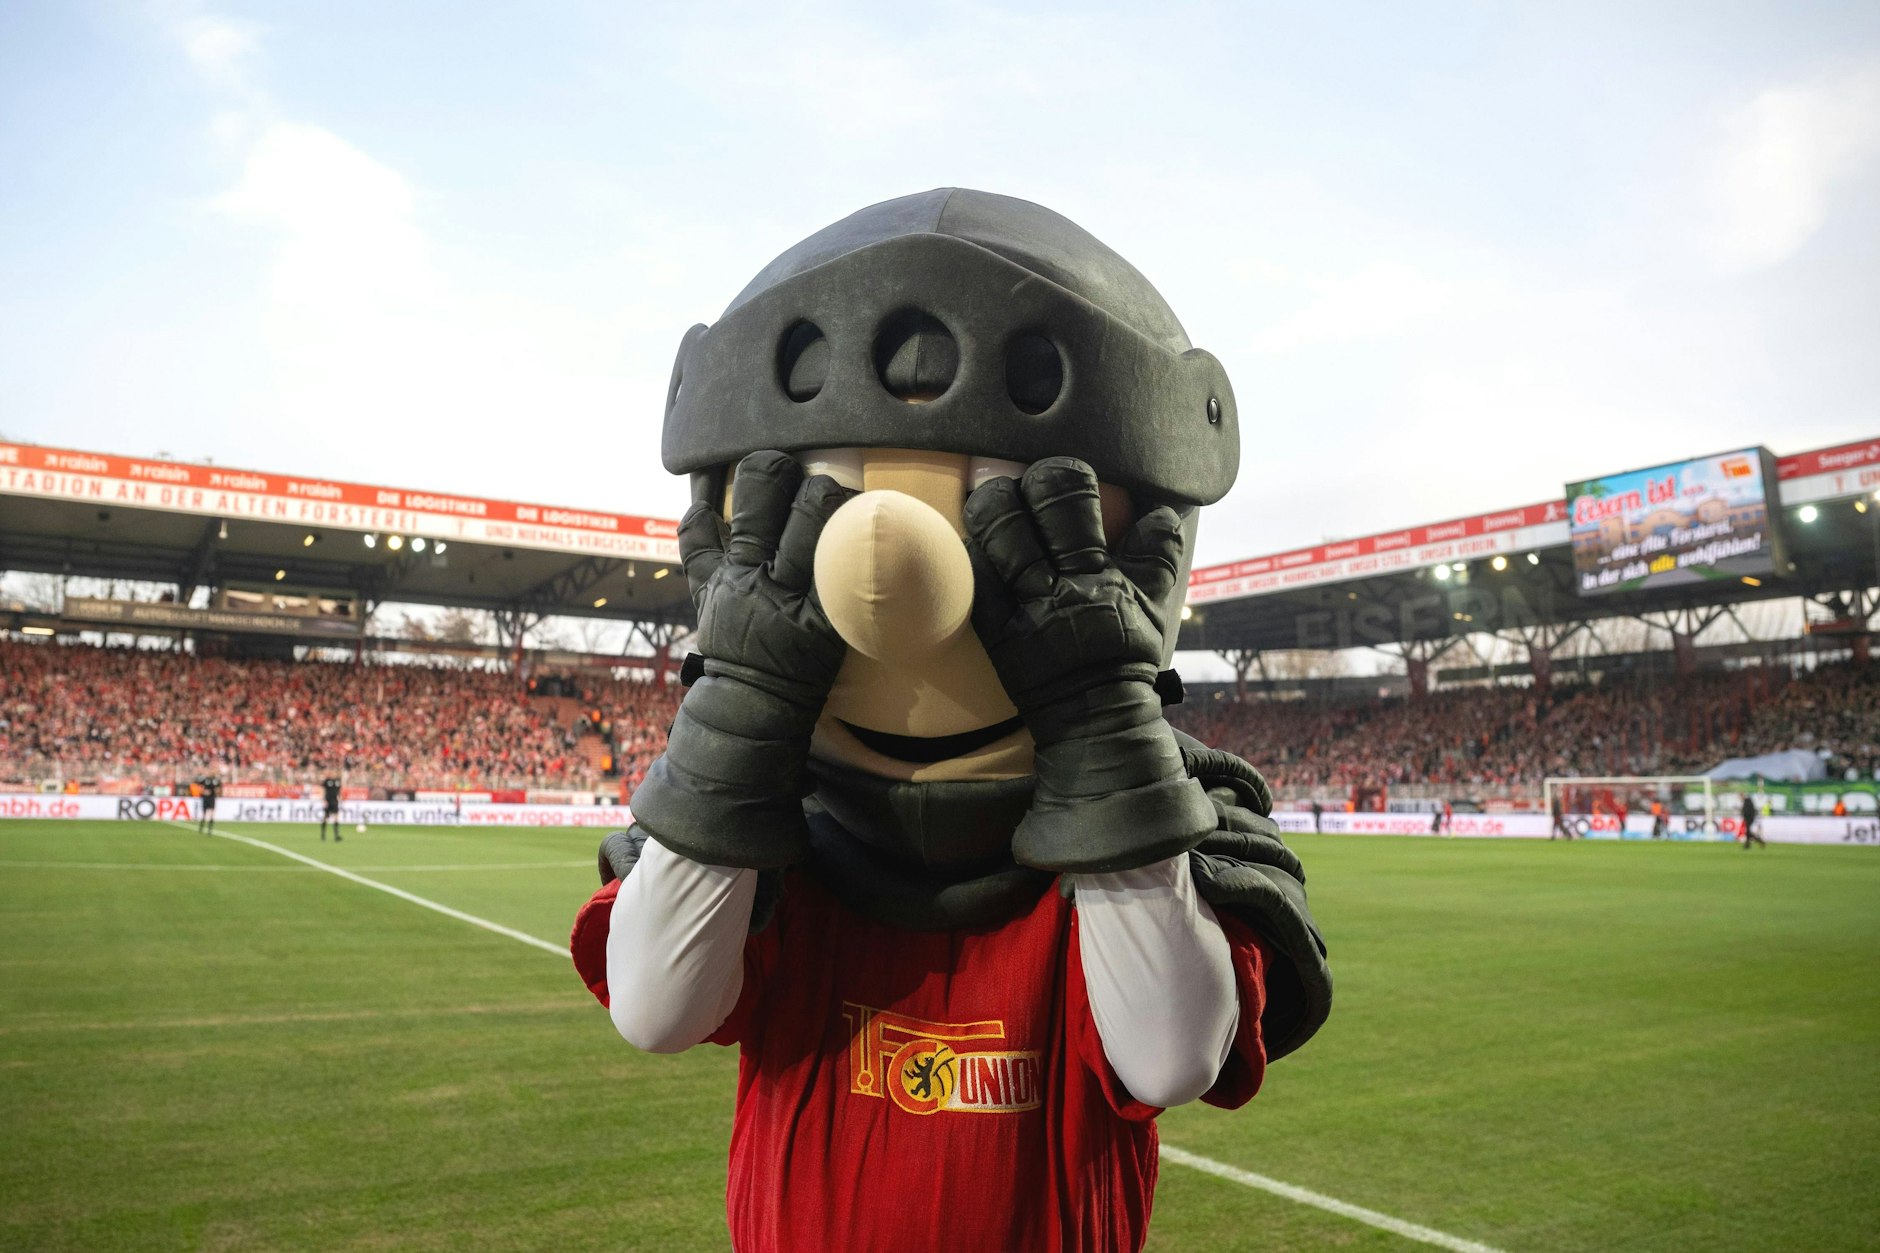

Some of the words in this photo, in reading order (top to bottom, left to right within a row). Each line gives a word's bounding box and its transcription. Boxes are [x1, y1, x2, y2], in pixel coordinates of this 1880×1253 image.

[60, 453, 107, 473] raisin
[144, 464, 190, 482] raisin
[0, 470, 102, 496] TADION
[115, 483, 146, 501] AN
[161, 488, 204, 506] DER
[219, 493, 287, 516] ALTEN
[223, 474, 267, 490] raisin
[300, 483, 342, 499] raisin
[377, 491, 400, 506] DIE
[405, 494, 487, 516] LOGISTIKER
[1575, 491, 1643, 525] Eisern
[1646, 475, 1677, 505] ist
[516, 506, 538, 522] DIE
[543, 510, 618, 530] LOGISTIKER
[518, 527, 573, 546] NIEMALS
[118, 798, 193, 821] ROPA
[235, 802, 283, 821] Jetzt
[290, 803, 406, 823] infomieren
[468, 807, 636, 826] www.ropa-gmbh.
